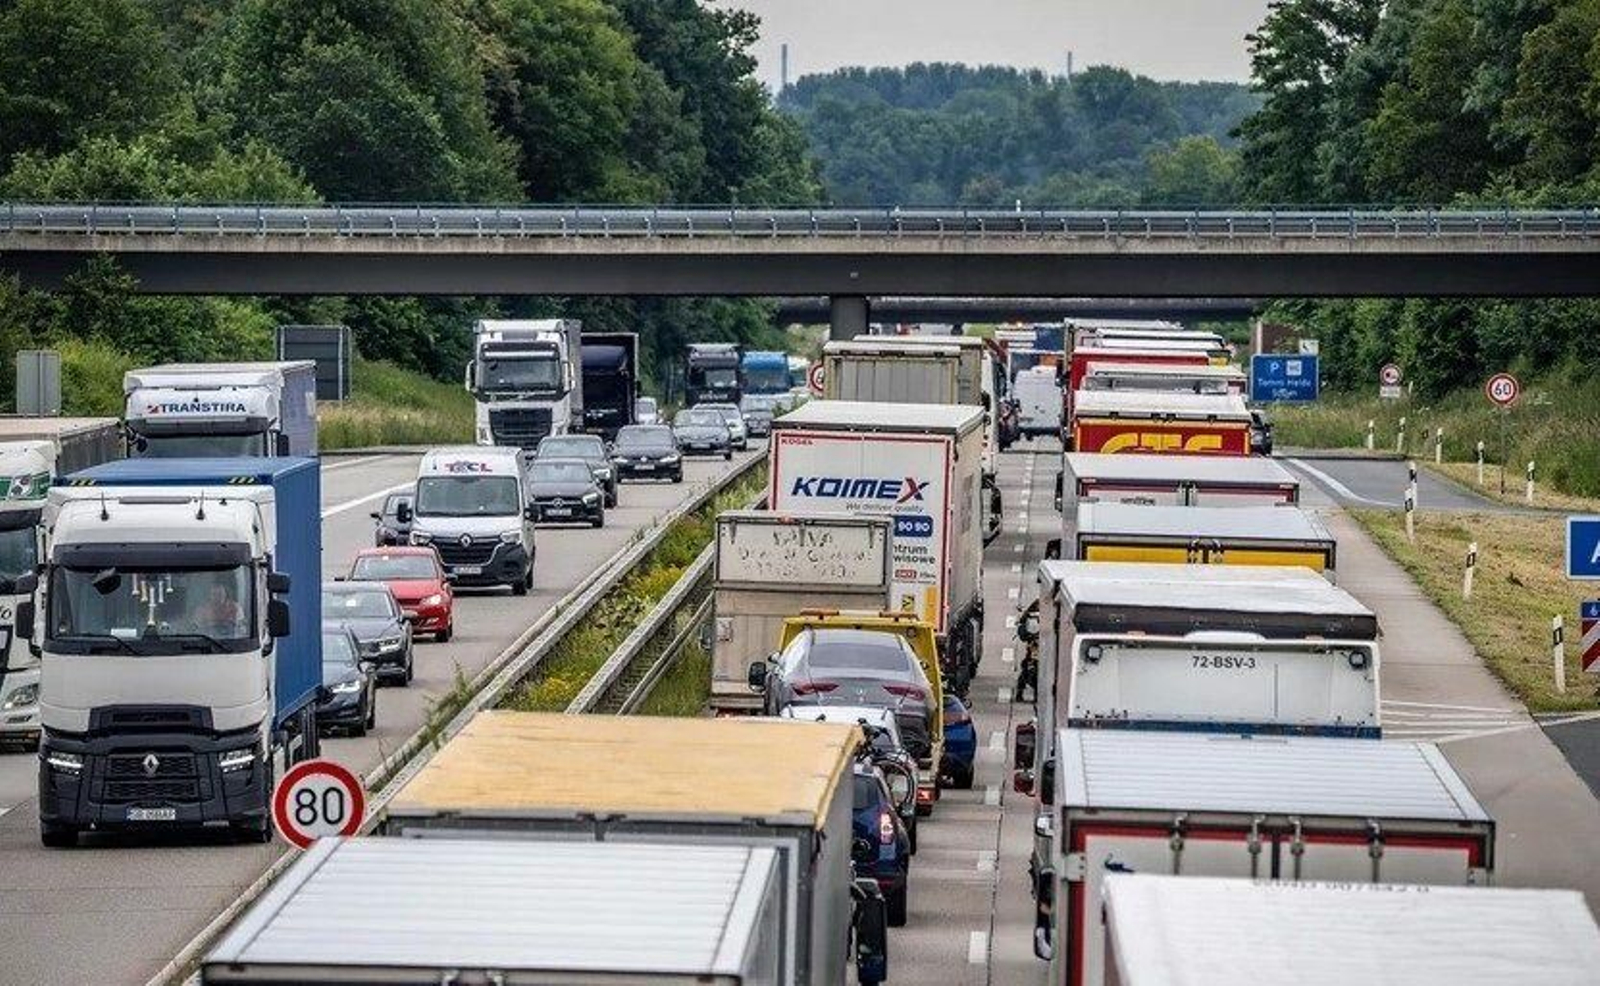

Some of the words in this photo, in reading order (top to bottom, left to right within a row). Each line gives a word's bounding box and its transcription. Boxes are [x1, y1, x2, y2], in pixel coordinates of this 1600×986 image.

[1495, 382, 1511, 396] 60
[160, 402, 247, 413] TRANSTIRA
[791, 477, 930, 503] KOIMEX
[1192, 655, 1256, 669] 72-BSV-3
[295, 786, 345, 826] 80
